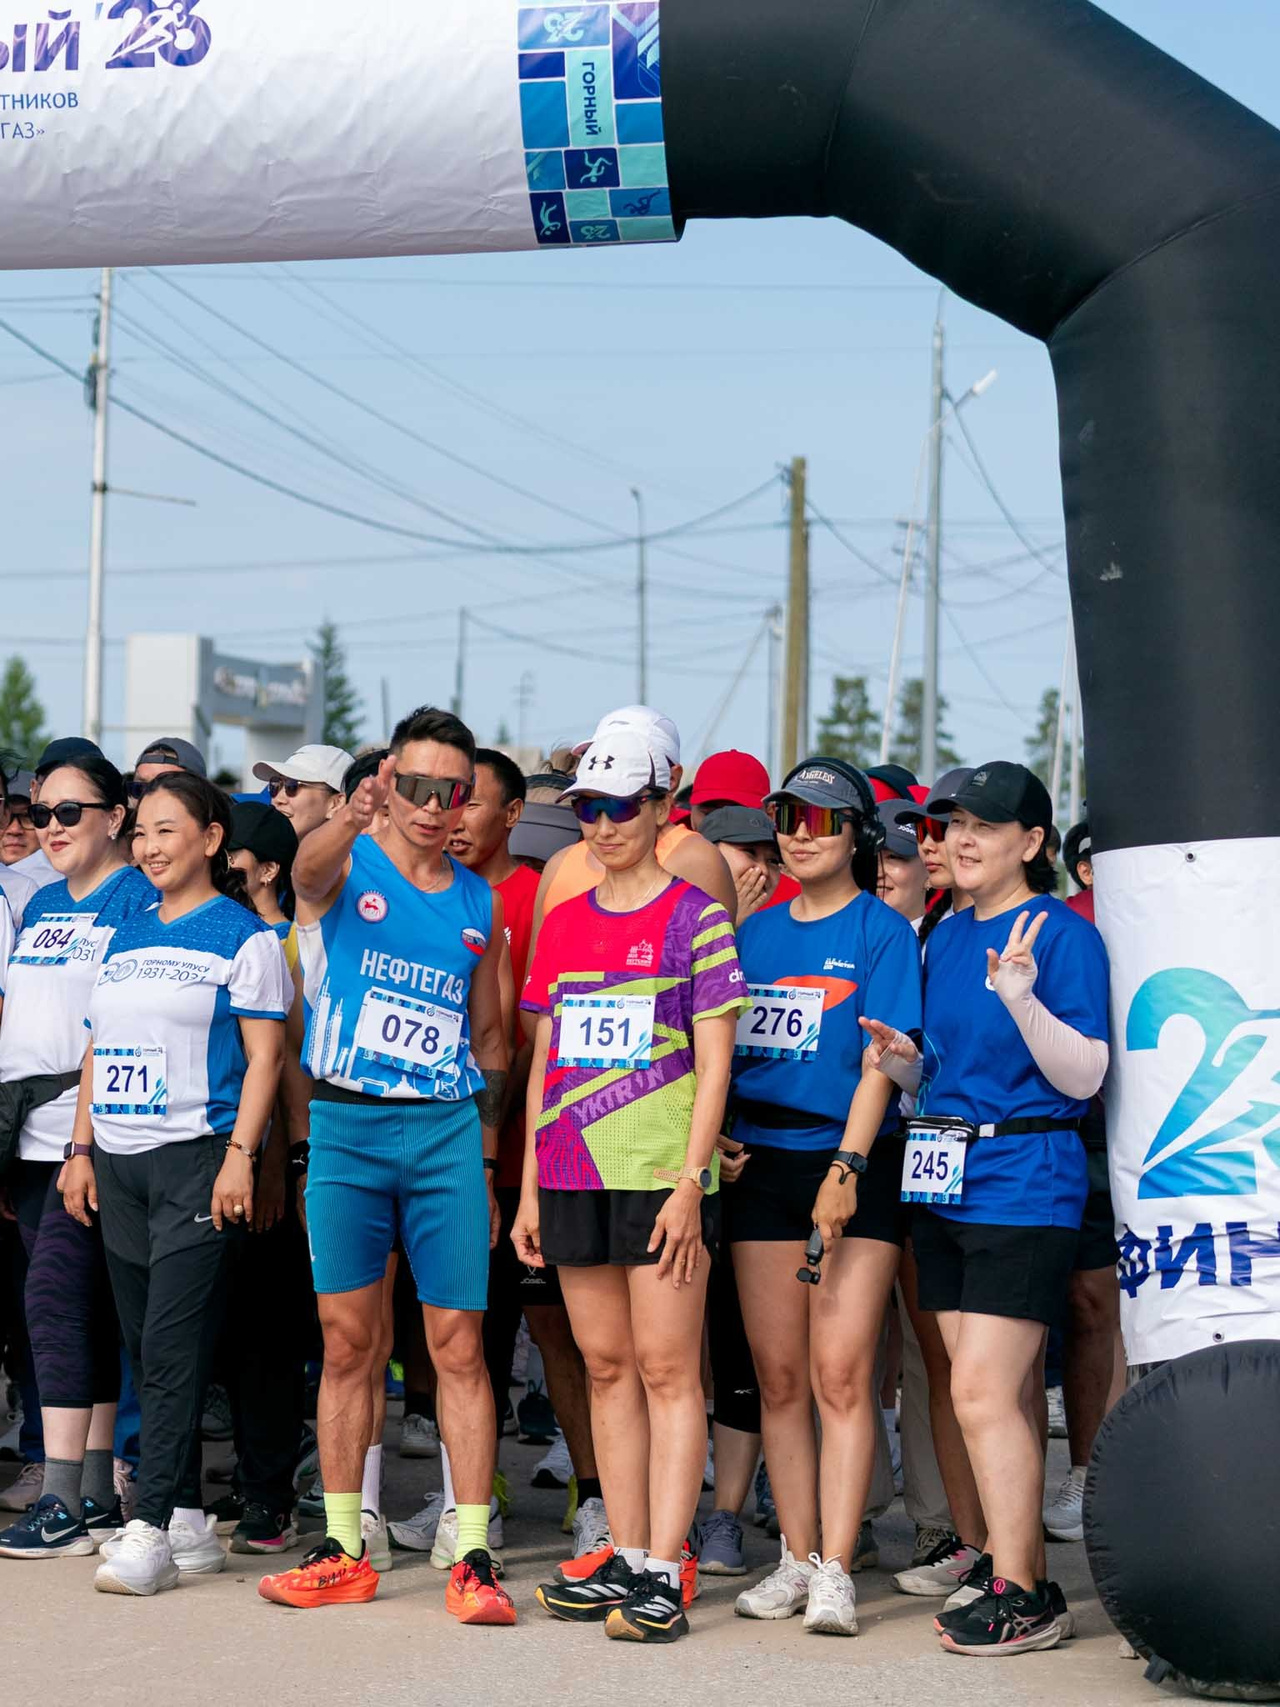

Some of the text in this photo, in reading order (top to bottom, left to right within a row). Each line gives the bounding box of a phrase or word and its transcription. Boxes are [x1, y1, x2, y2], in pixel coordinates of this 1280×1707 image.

[582, 62, 602, 136] ГОРНЫЙ
[32, 928, 75, 949] 084
[142, 959, 211, 973] ГОРНОМУ УЛУСУ
[360, 948, 465, 1005] НЕФТЕГАЗ
[382, 1014, 440, 1055] 078
[580, 1017, 630, 1046] 151
[750, 1006, 803, 1037] 276
[106, 1064, 148, 1093] 271
[1126, 967, 1280, 1200] 2
[911, 1150, 949, 1180] 245
